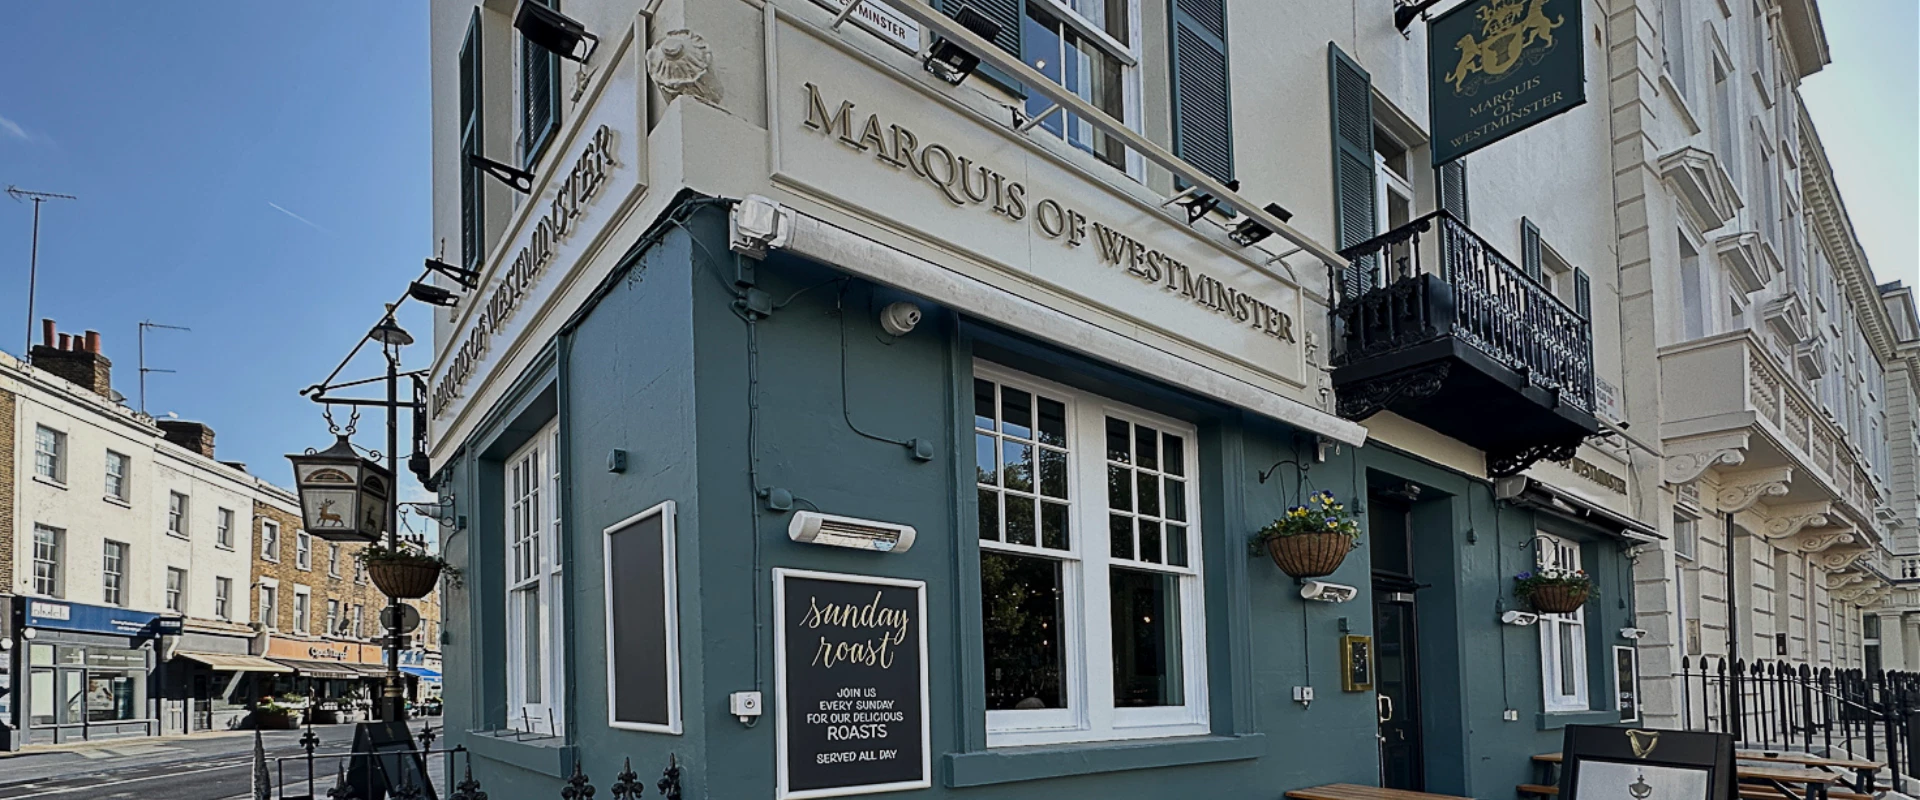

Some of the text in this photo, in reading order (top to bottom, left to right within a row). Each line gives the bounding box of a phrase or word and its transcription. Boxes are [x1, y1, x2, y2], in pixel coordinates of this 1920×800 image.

[1469, 76, 1541, 117] MARQUIS
[1493, 102, 1514, 117] OF
[1450, 91, 1563, 148] WESTMINSTER
[804, 82, 1297, 344] MARQUIS OF WESTMINSTER
[432, 124, 615, 421] MARQUIS OF WESTMINSTER
[799, 591, 909, 645] sunday
[811, 631, 894, 669] roast
[819, 700, 895, 711] EVERY SUNDAY
[836, 687, 877, 699] JOIN US
[806, 711, 904, 724] FOR OUR DELICIOUS
[827, 723, 888, 741] ROASTS
[816, 749, 898, 764] SERVED ALL DAY
